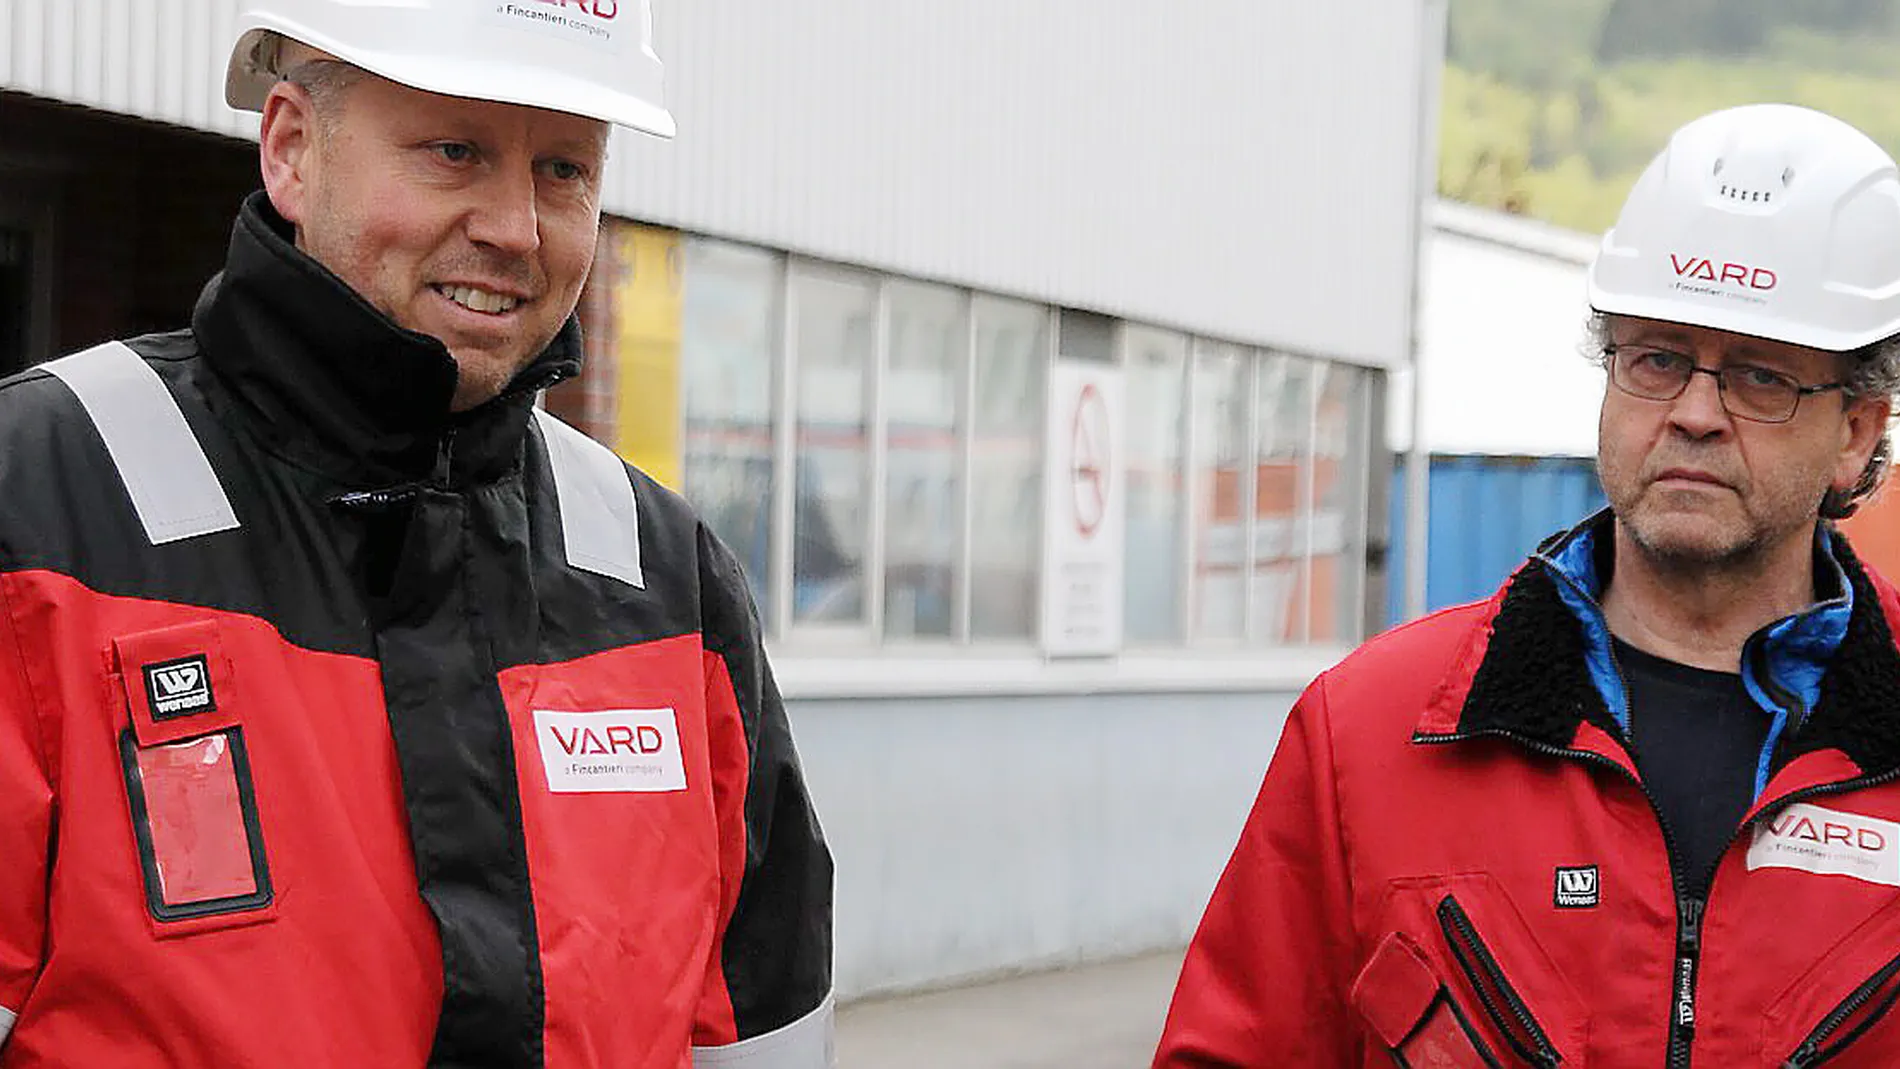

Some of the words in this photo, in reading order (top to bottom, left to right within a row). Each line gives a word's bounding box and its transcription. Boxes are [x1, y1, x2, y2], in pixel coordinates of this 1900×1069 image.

[1670, 253, 1777, 290] VARD
[550, 725, 663, 756] VARD
[1767, 814, 1886, 851] VARD
